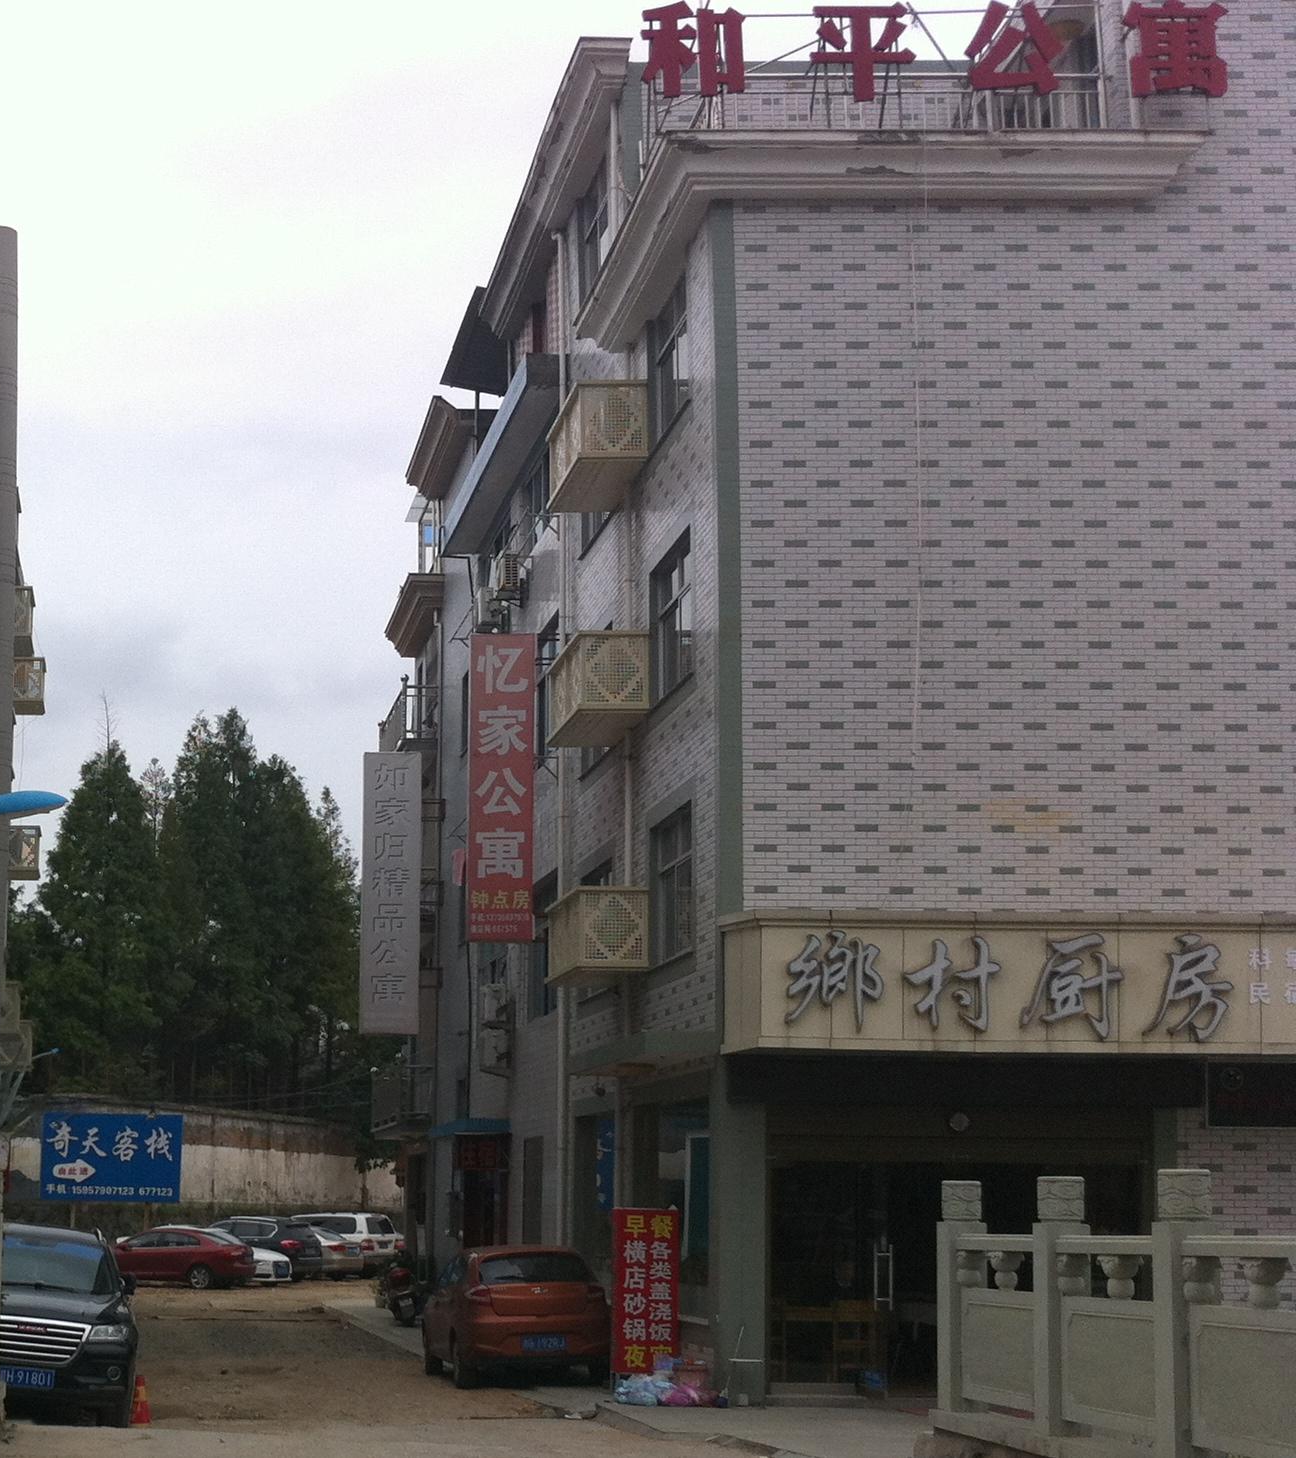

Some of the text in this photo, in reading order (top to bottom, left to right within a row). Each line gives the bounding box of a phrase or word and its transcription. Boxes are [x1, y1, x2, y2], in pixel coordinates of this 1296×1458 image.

[641, 1, 1228, 102] 和平公寓
[475, 645, 528, 879] 忆家公寓
[471, 889, 530, 910] 钟点房
